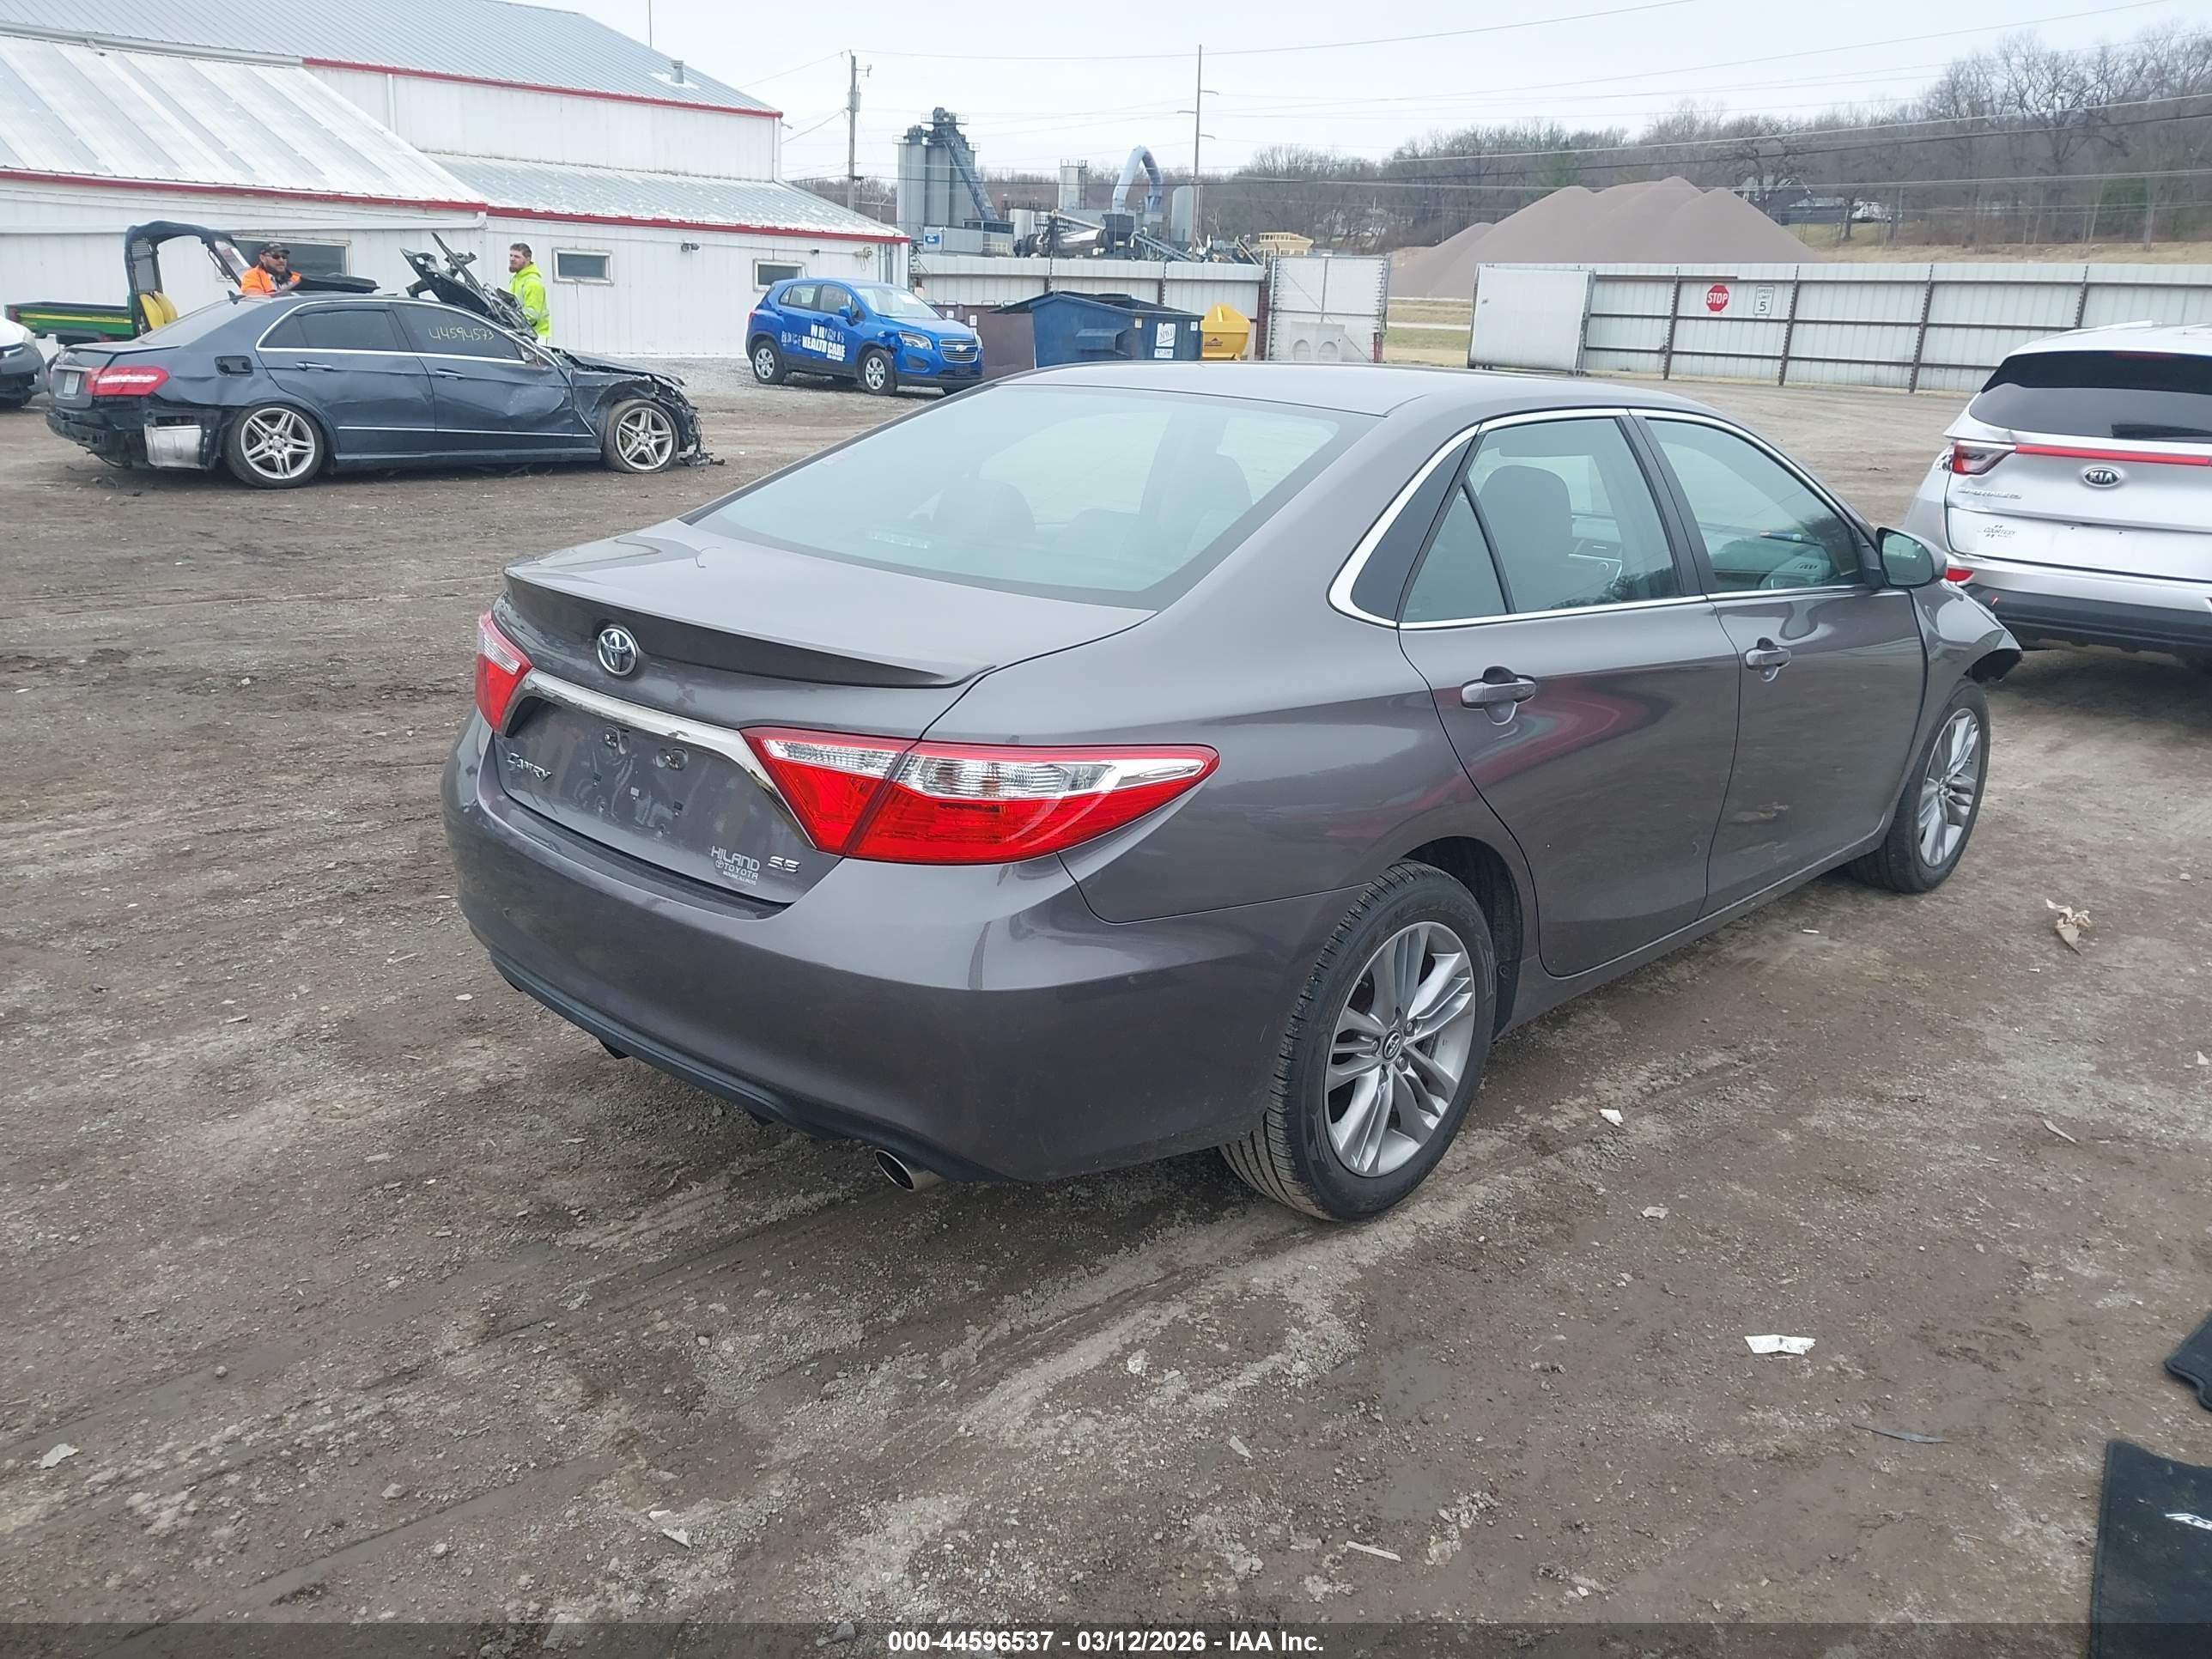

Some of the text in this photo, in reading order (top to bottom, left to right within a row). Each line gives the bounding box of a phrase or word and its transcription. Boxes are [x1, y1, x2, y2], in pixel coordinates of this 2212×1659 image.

[1707, 292, 1728, 304] STOP
[1759, 301, 1766, 312] 5
[828, 342, 846, 358] CARE
[2088, 471, 2113, 483] KIA
[710, 845, 761, 872] HILAND
[768, 855, 800, 872] SE
[724, 861, 759, 880] TOYOTA
